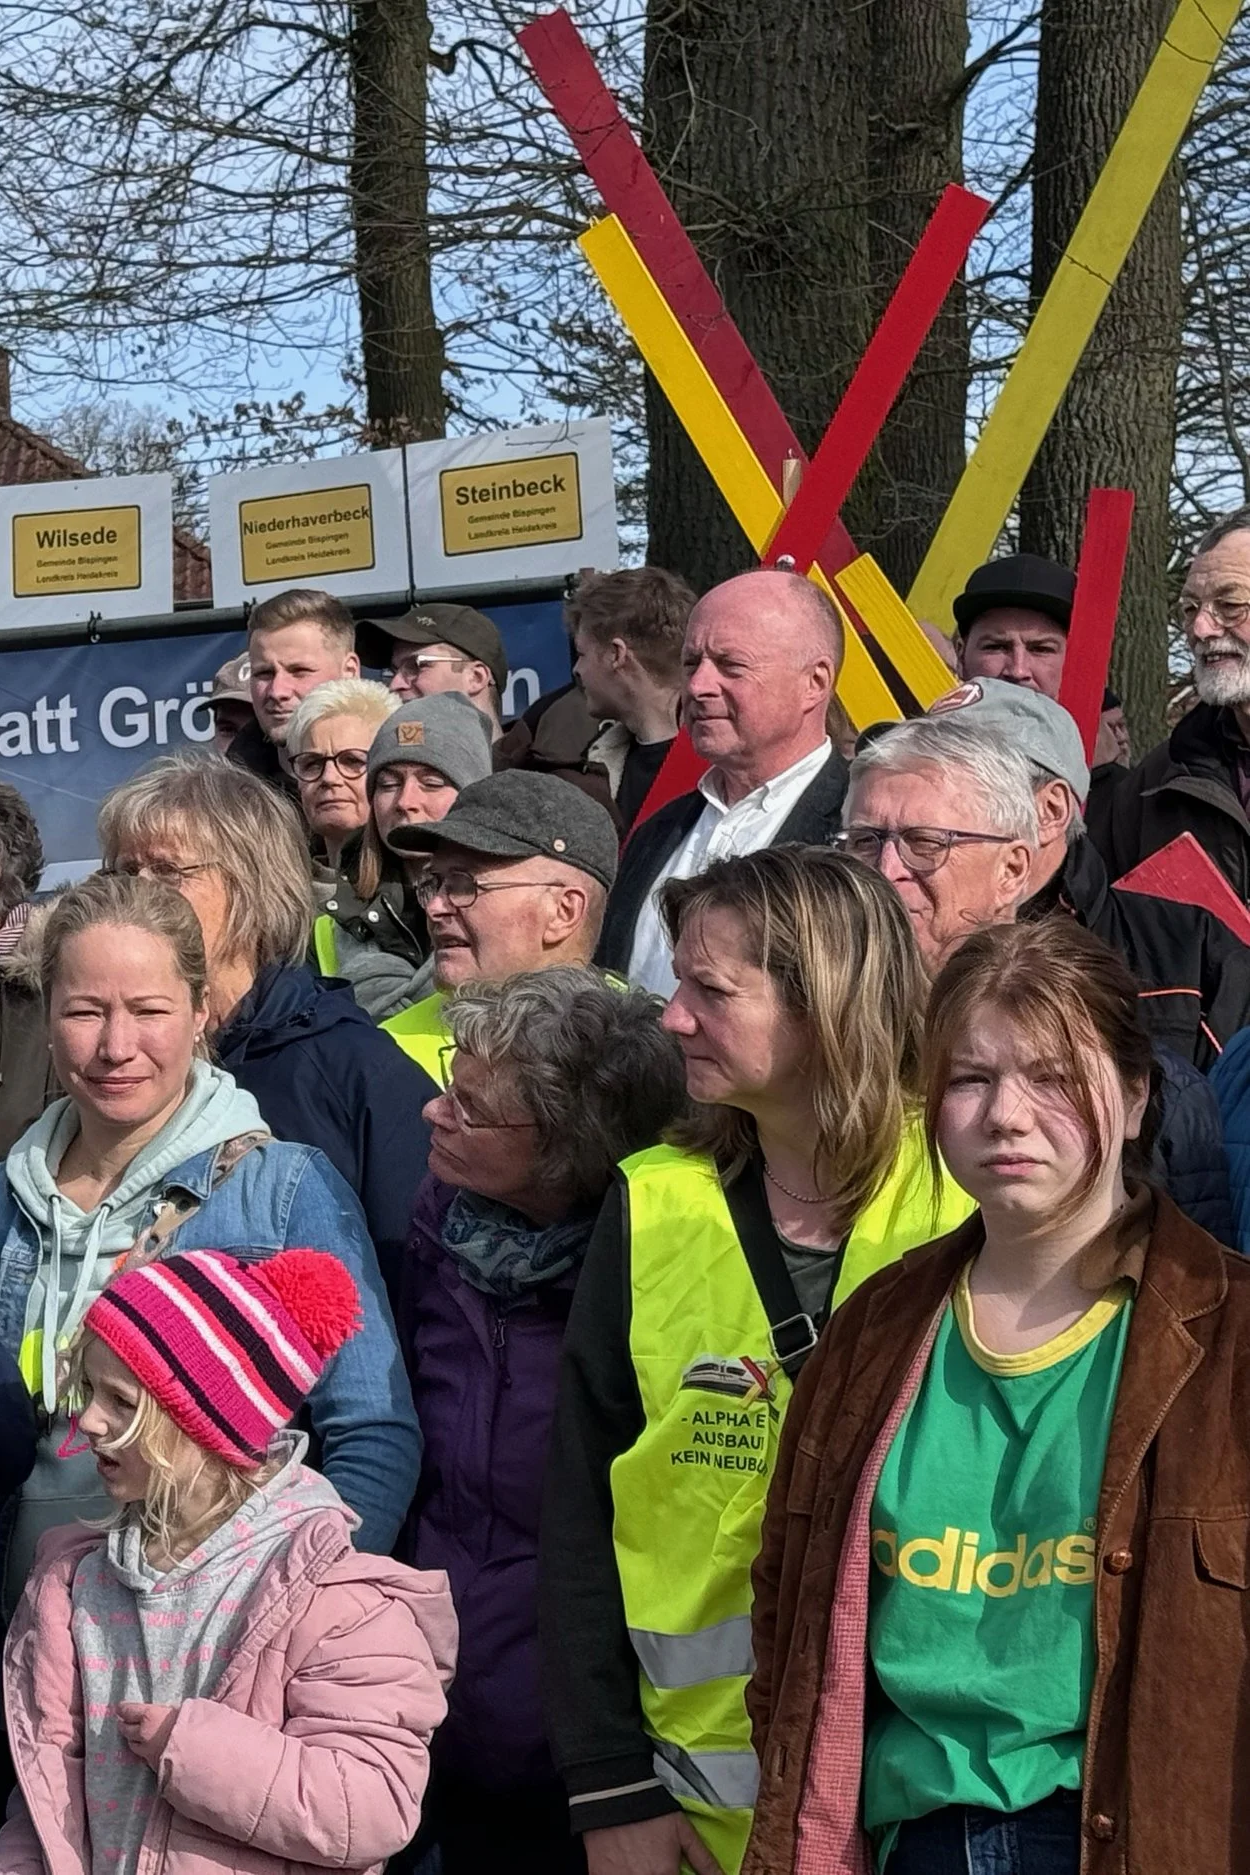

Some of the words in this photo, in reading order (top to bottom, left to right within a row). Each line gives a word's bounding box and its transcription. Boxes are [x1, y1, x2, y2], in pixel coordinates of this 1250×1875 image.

[455, 474, 566, 505] Steinbeck
[243, 505, 370, 535] Niederhaverbeck
[36, 526, 118, 549] Wilsede
[692, 1411, 751, 1427] ALPHA
[671, 1450, 710, 1465] KEIN
[872, 1526, 1096, 1598] adidas
